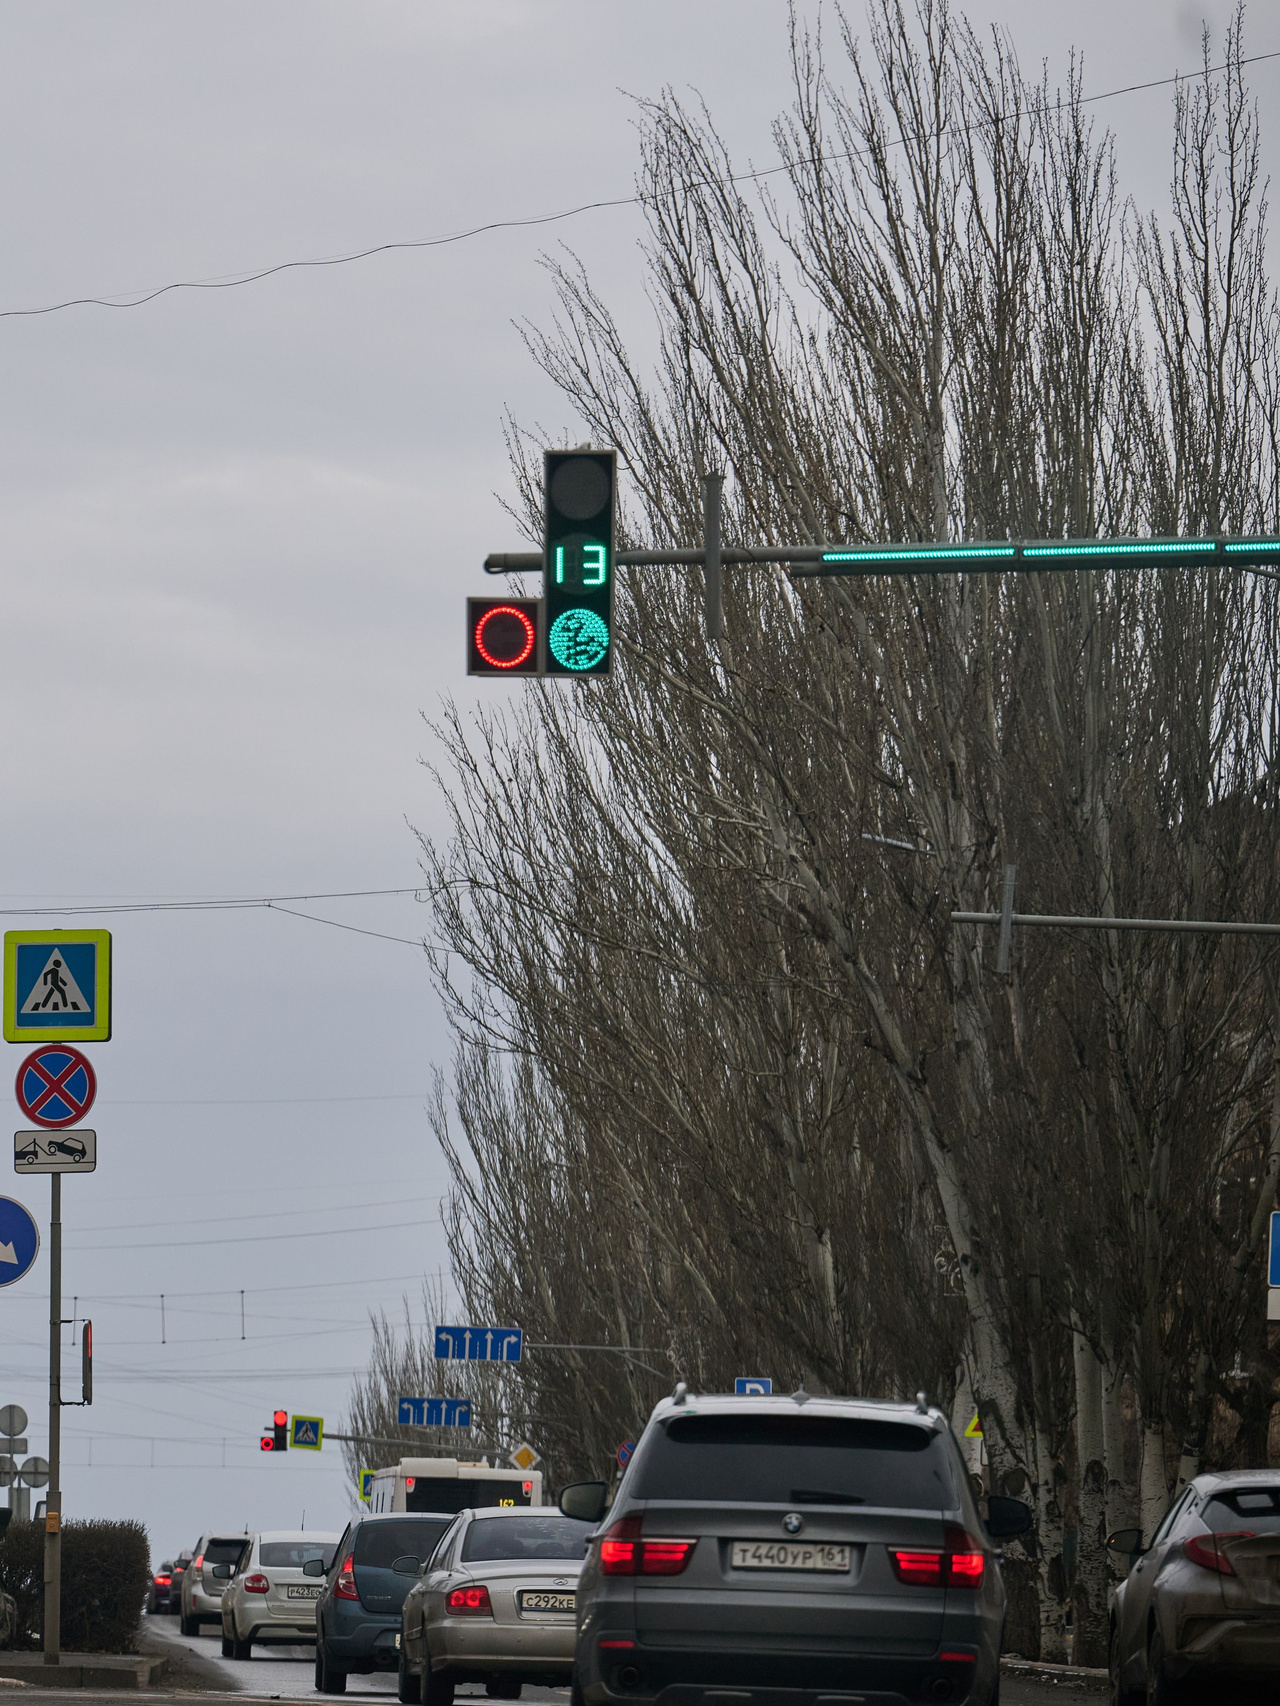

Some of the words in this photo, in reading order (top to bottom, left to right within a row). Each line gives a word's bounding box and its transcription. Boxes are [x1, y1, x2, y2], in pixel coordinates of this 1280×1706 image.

[556, 545, 606, 585] 13
[739, 1545, 812, 1565] Т440УР
[817, 1547, 846, 1561] 161
[526, 1595, 574, 1609] С292КЕ
